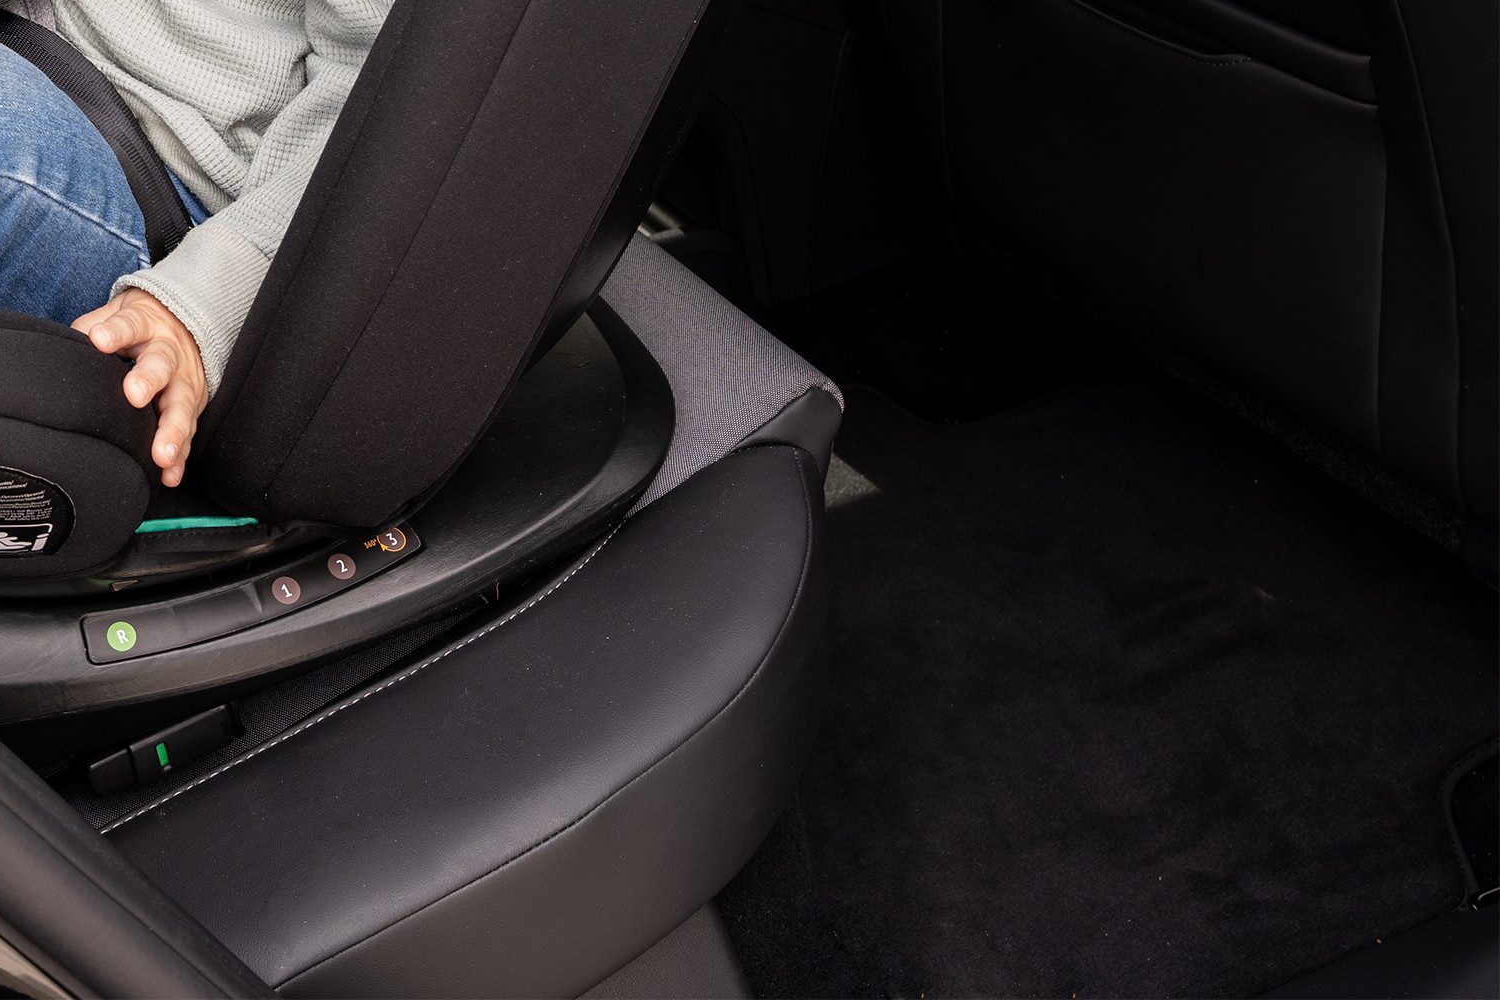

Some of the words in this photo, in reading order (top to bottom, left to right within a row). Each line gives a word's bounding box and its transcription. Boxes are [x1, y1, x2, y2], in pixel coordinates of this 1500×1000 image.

[385, 532, 398, 546] 3
[335, 558, 349, 573] 2
[280, 583, 293, 599] 1
[116, 628, 130, 645] R
